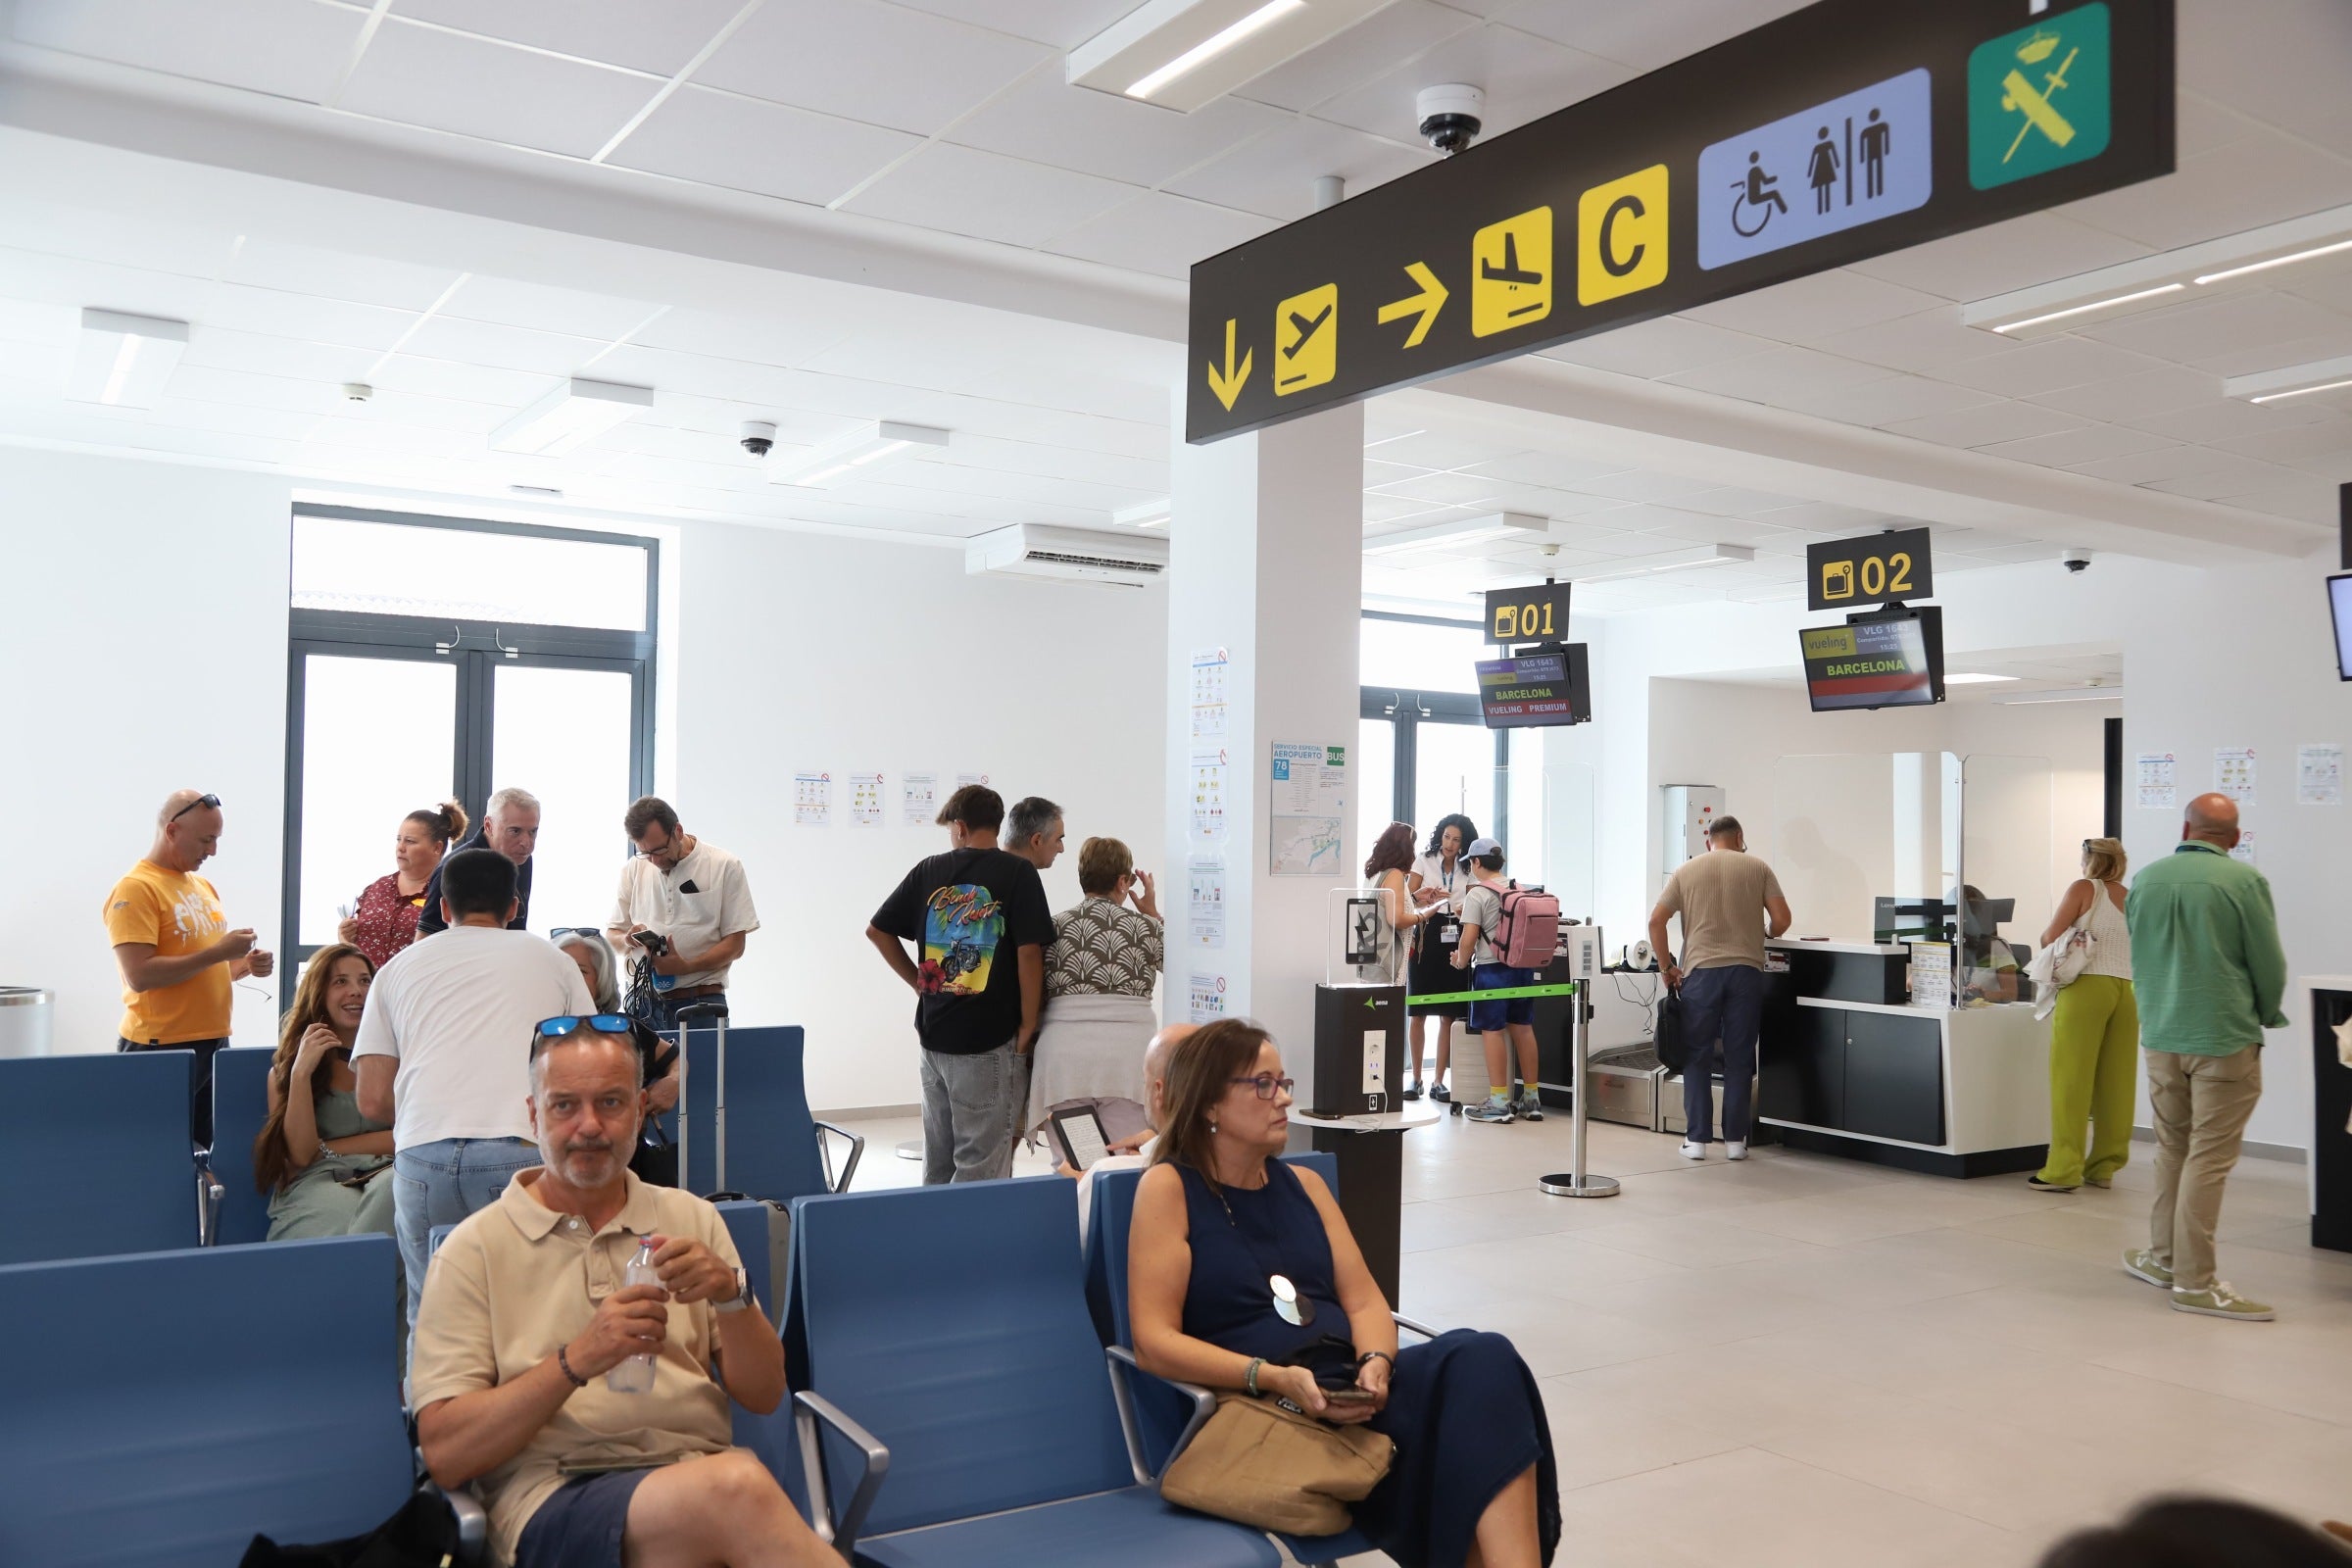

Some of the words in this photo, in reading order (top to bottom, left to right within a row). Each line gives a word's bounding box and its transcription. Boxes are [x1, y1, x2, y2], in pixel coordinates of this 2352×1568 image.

[1599, 195, 1645, 276] C
[1861, 553, 1912, 596] 02
[1522, 603, 1553, 636] 01
[1863, 625, 1883, 635] VLG
[1809, 635, 1847, 651] vueling
[1537, 658, 1554, 666] 1643
[1827, 659, 1906, 676] BARCELONA
[1495, 688, 1553, 701] BARCELONA
[1489, 705, 1523, 714] VUELING
[1529, 703, 1567, 712] PREMIUM
[1274, 750, 1322, 760] AEROPUERTO
[1327, 752, 1345, 761] BUS
[1275, 760, 1288, 770] 78
